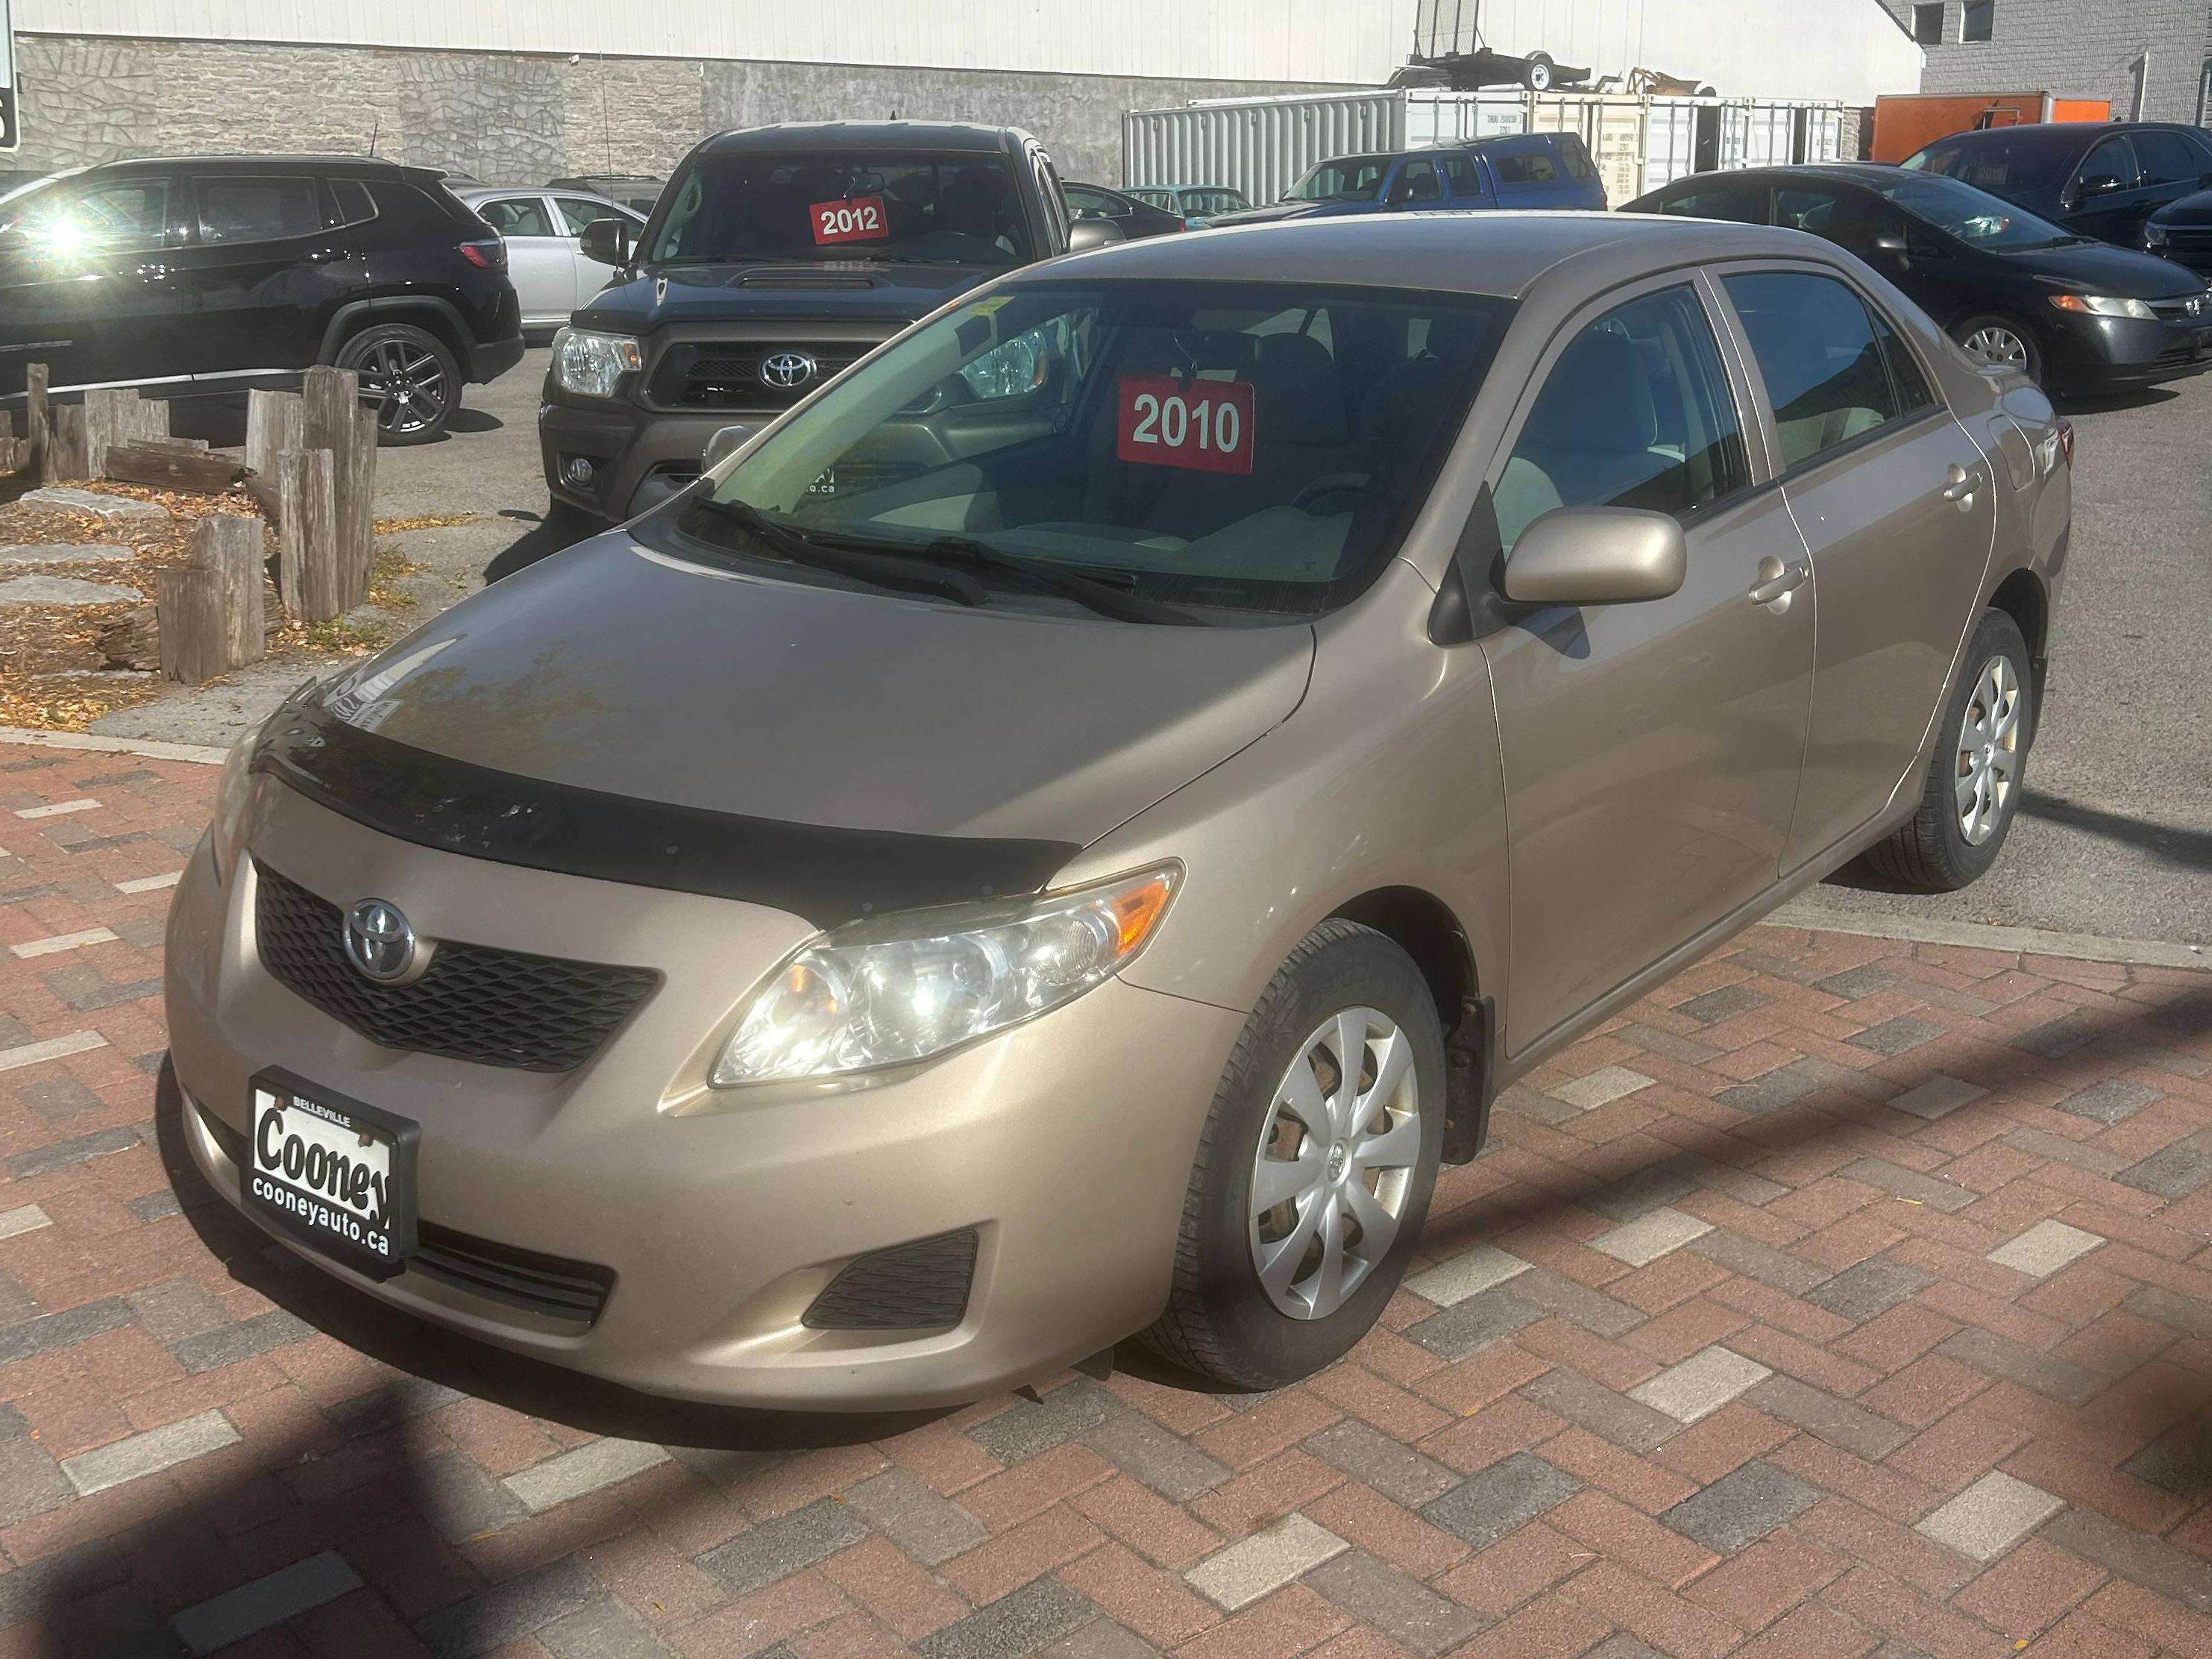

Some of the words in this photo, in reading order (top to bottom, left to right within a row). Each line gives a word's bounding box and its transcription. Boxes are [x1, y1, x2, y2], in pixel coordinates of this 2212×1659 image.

[821, 206, 879, 235] 2012
[1133, 393, 1239, 453] 2010
[293, 1096, 351, 1127] BELLEVILLE
[257, 1107, 390, 1228] Cooney
[252, 1177, 389, 1255] cooneyauto.ca
